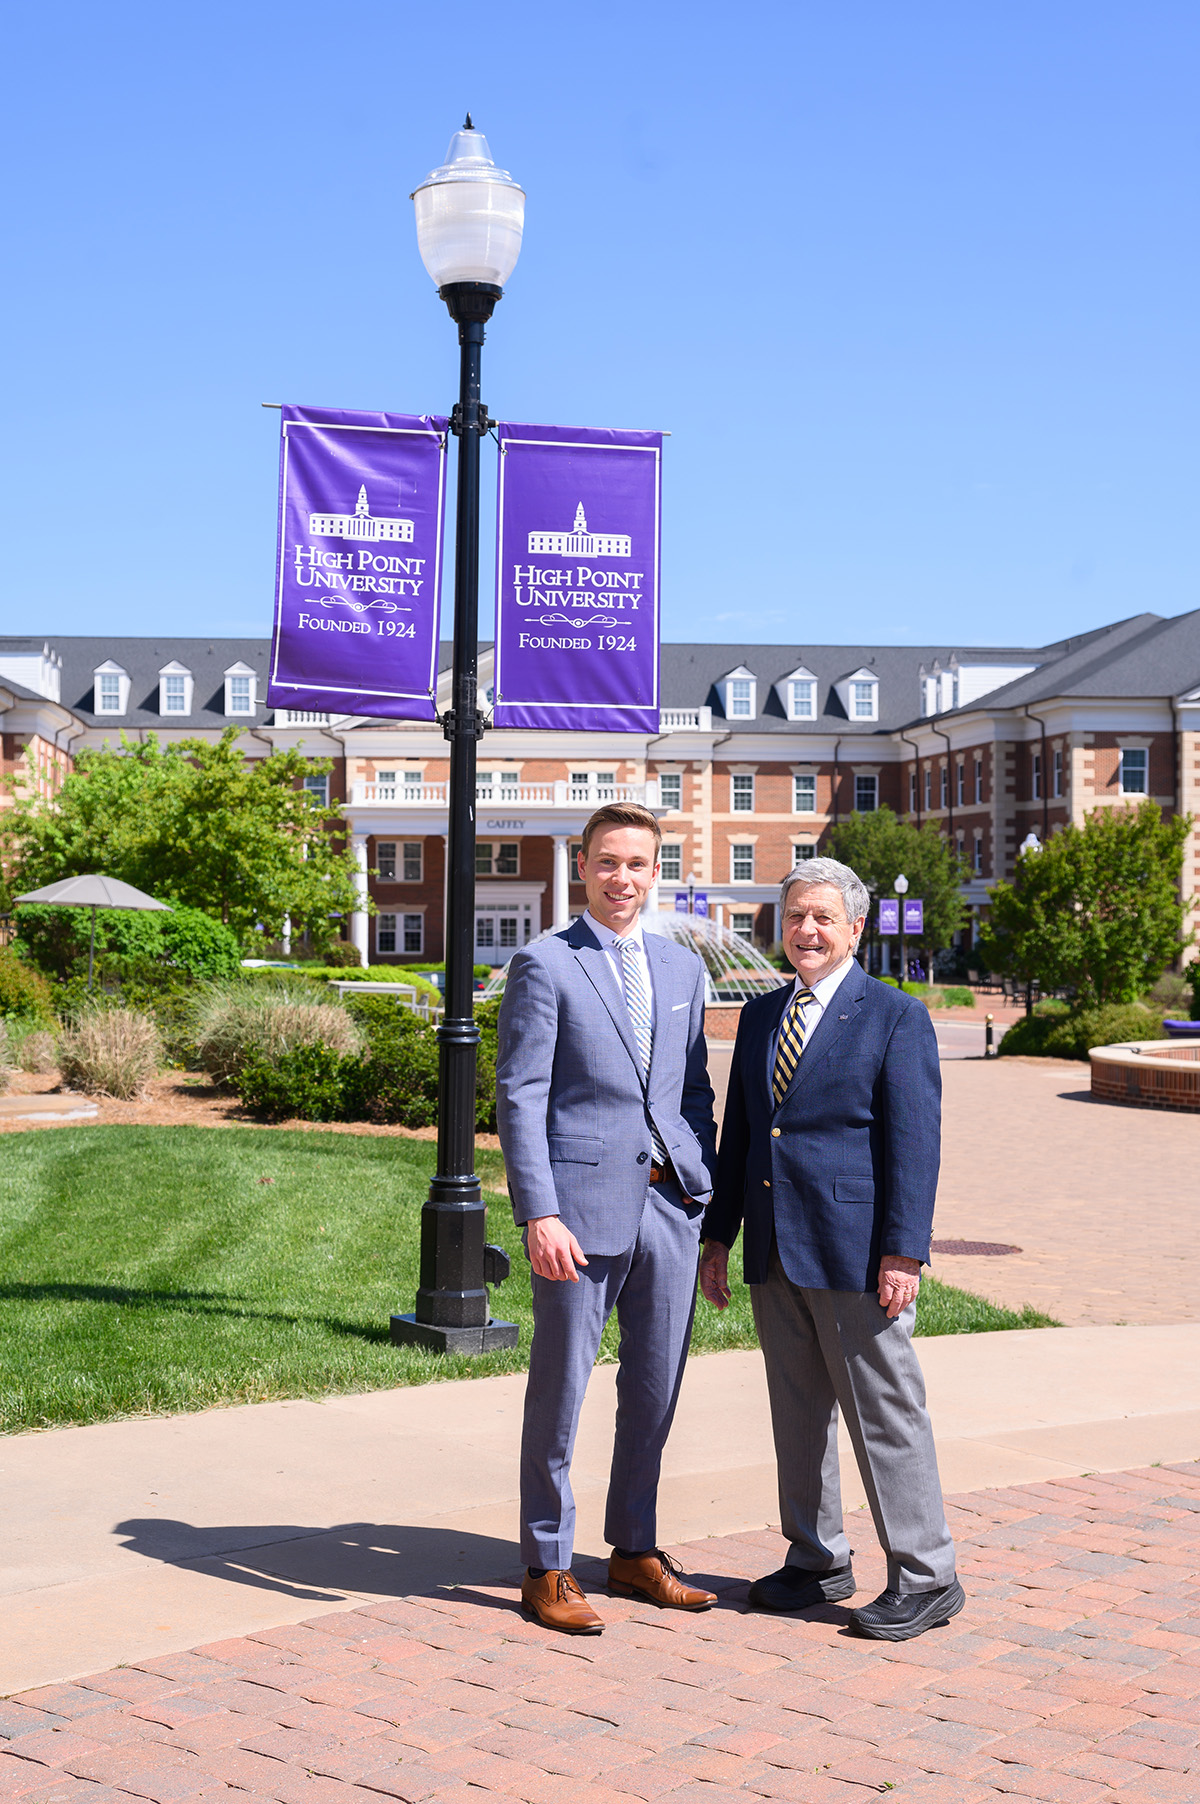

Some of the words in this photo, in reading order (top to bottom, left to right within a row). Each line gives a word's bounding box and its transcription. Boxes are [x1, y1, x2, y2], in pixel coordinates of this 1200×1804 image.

[294, 545, 353, 570] HIGH
[357, 550, 426, 575] POINT
[295, 566, 424, 597] UNIVERSITY
[513, 565, 573, 587] HIGH
[576, 567, 644, 590] POINT
[515, 586, 644, 610] UNIVERSITY
[298, 613, 371, 635] FOUNDED
[376, 620, 416, 639] 1924
[519, 633, 592, 650] FOUNDED
[597, 635, 637, 652] 1924
[486, 819, 526, 829] CAFFEY
